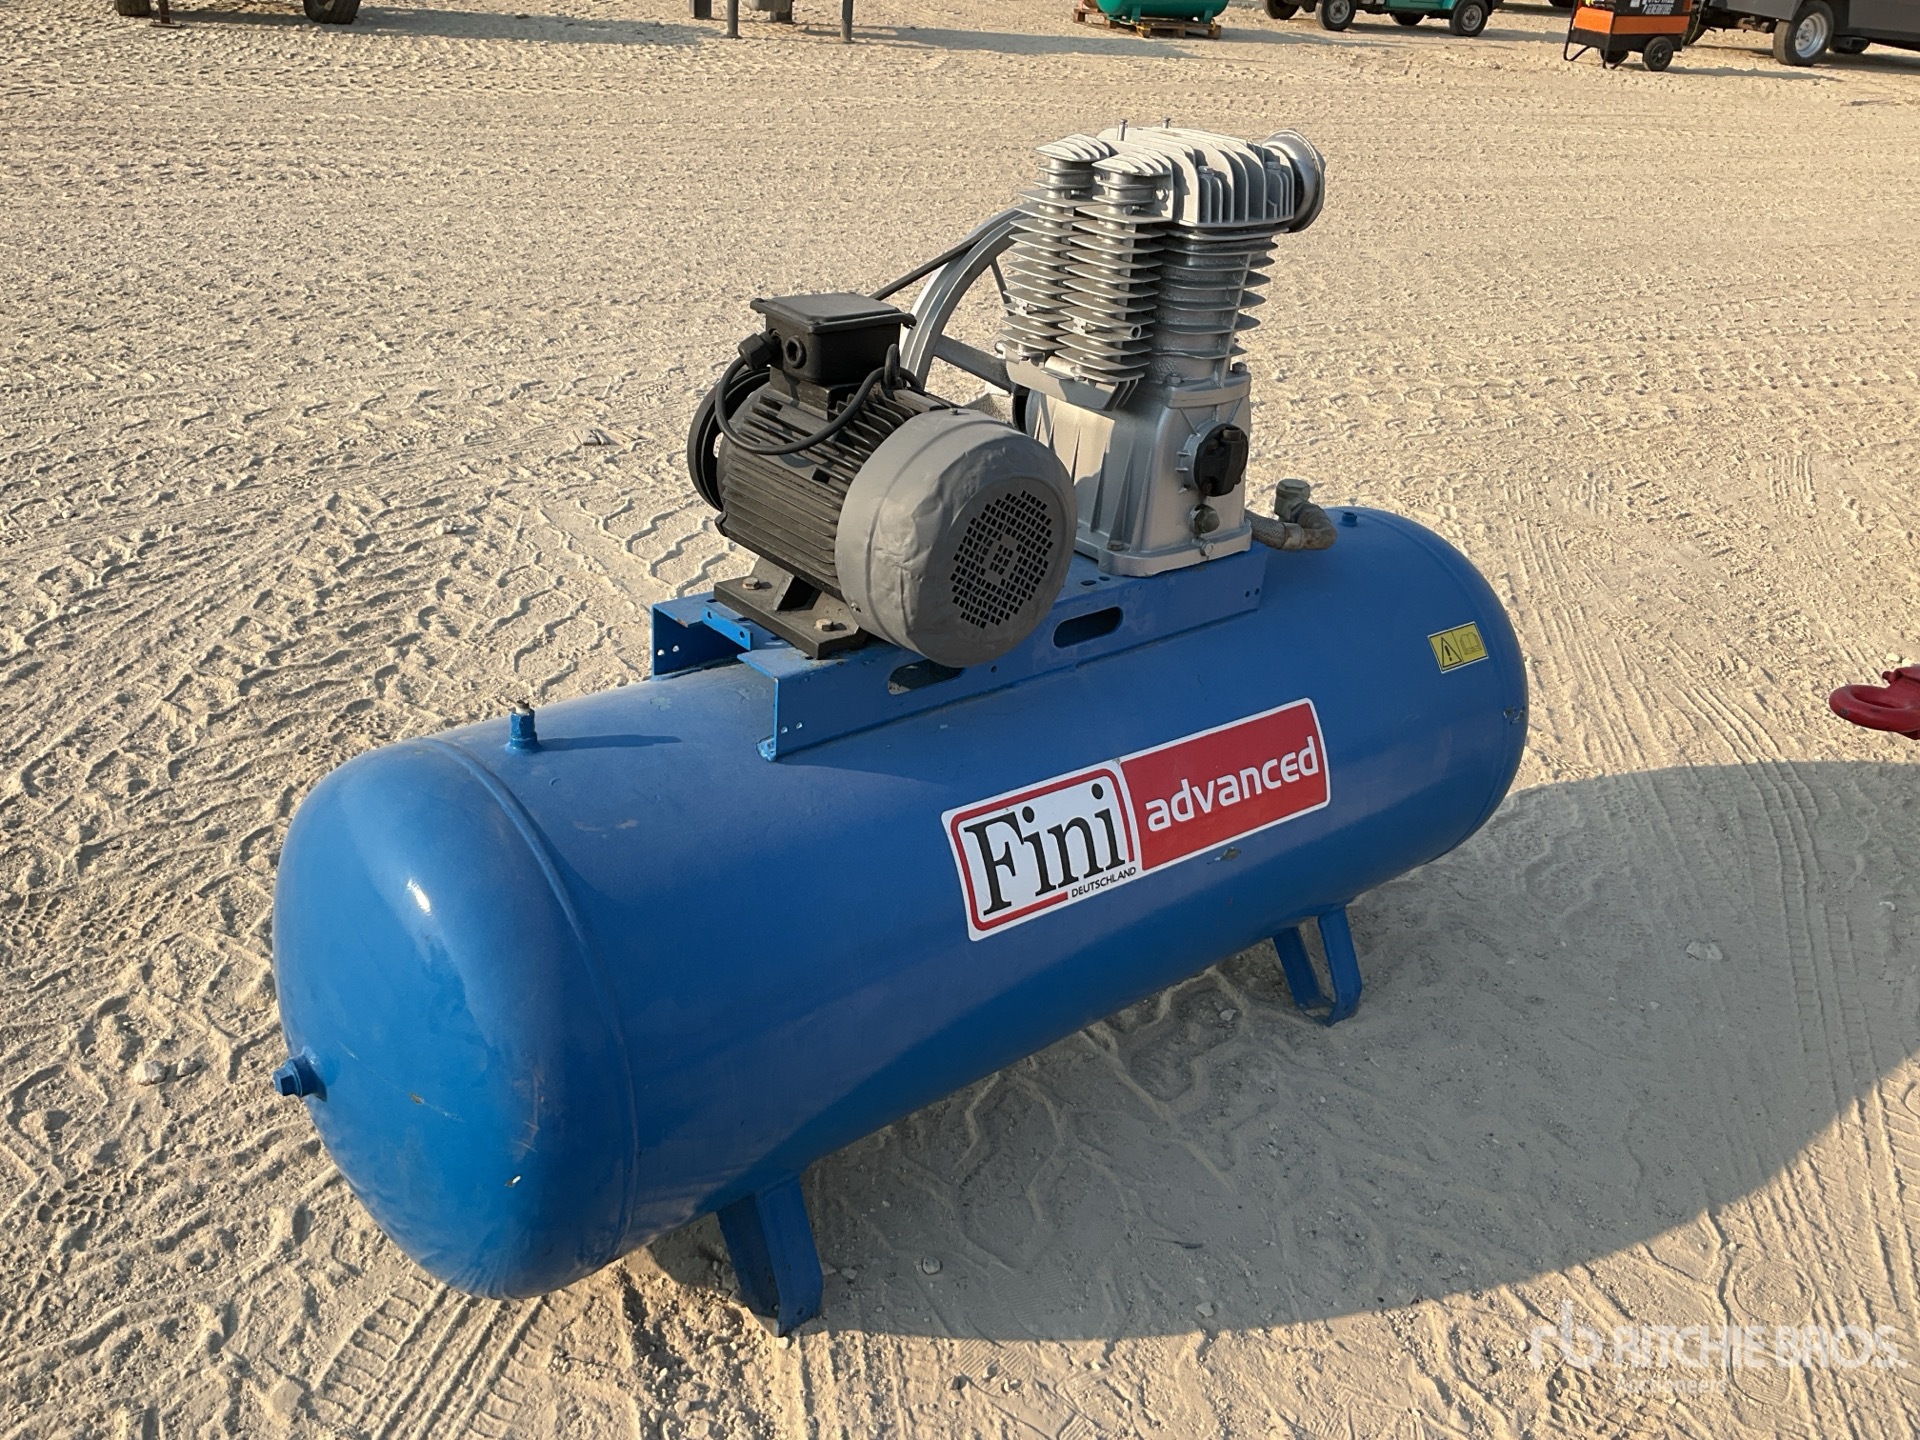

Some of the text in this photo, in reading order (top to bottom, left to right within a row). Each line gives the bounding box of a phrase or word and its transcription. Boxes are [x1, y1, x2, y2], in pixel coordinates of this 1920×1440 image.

[1145, 736, 1319, 832] advanced
[963, 783, 1126, 917] Fini
[1071, 866, 1137, 898] DEUTSCHLAND
